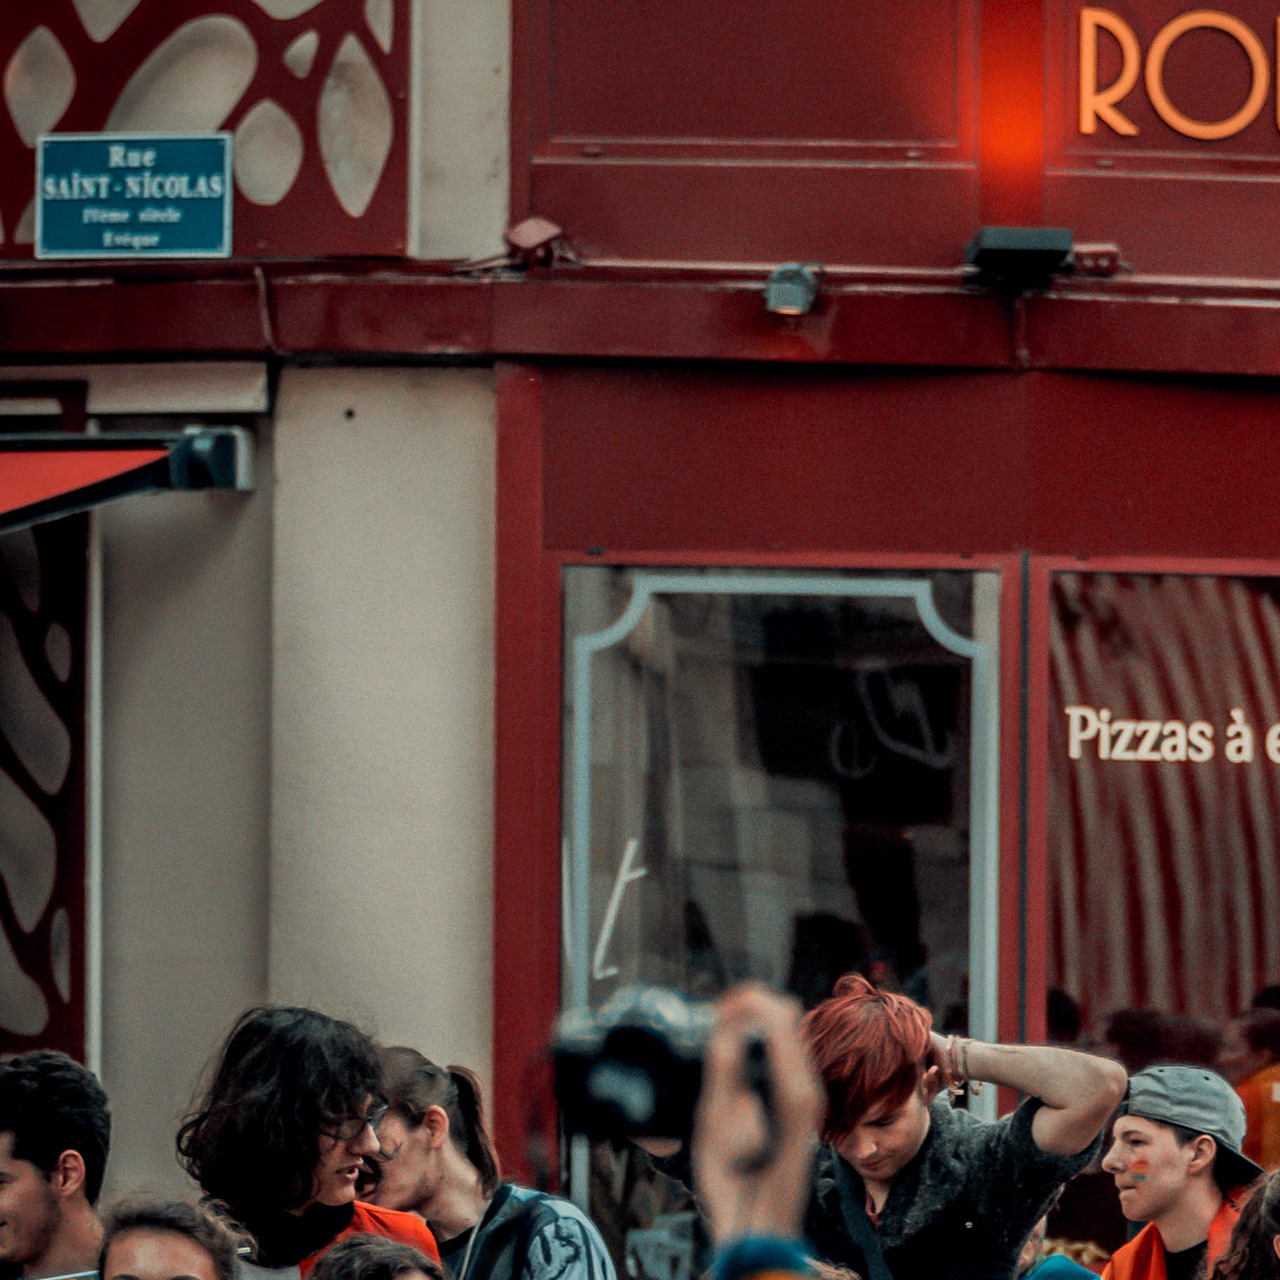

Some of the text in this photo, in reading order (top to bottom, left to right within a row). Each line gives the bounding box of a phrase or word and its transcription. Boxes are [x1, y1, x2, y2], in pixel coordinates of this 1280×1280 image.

[108, 145, 157, 168] Rue
[1064, 705, 1215, 763] Pizzas
[1225, 707, 1255, 763] à
